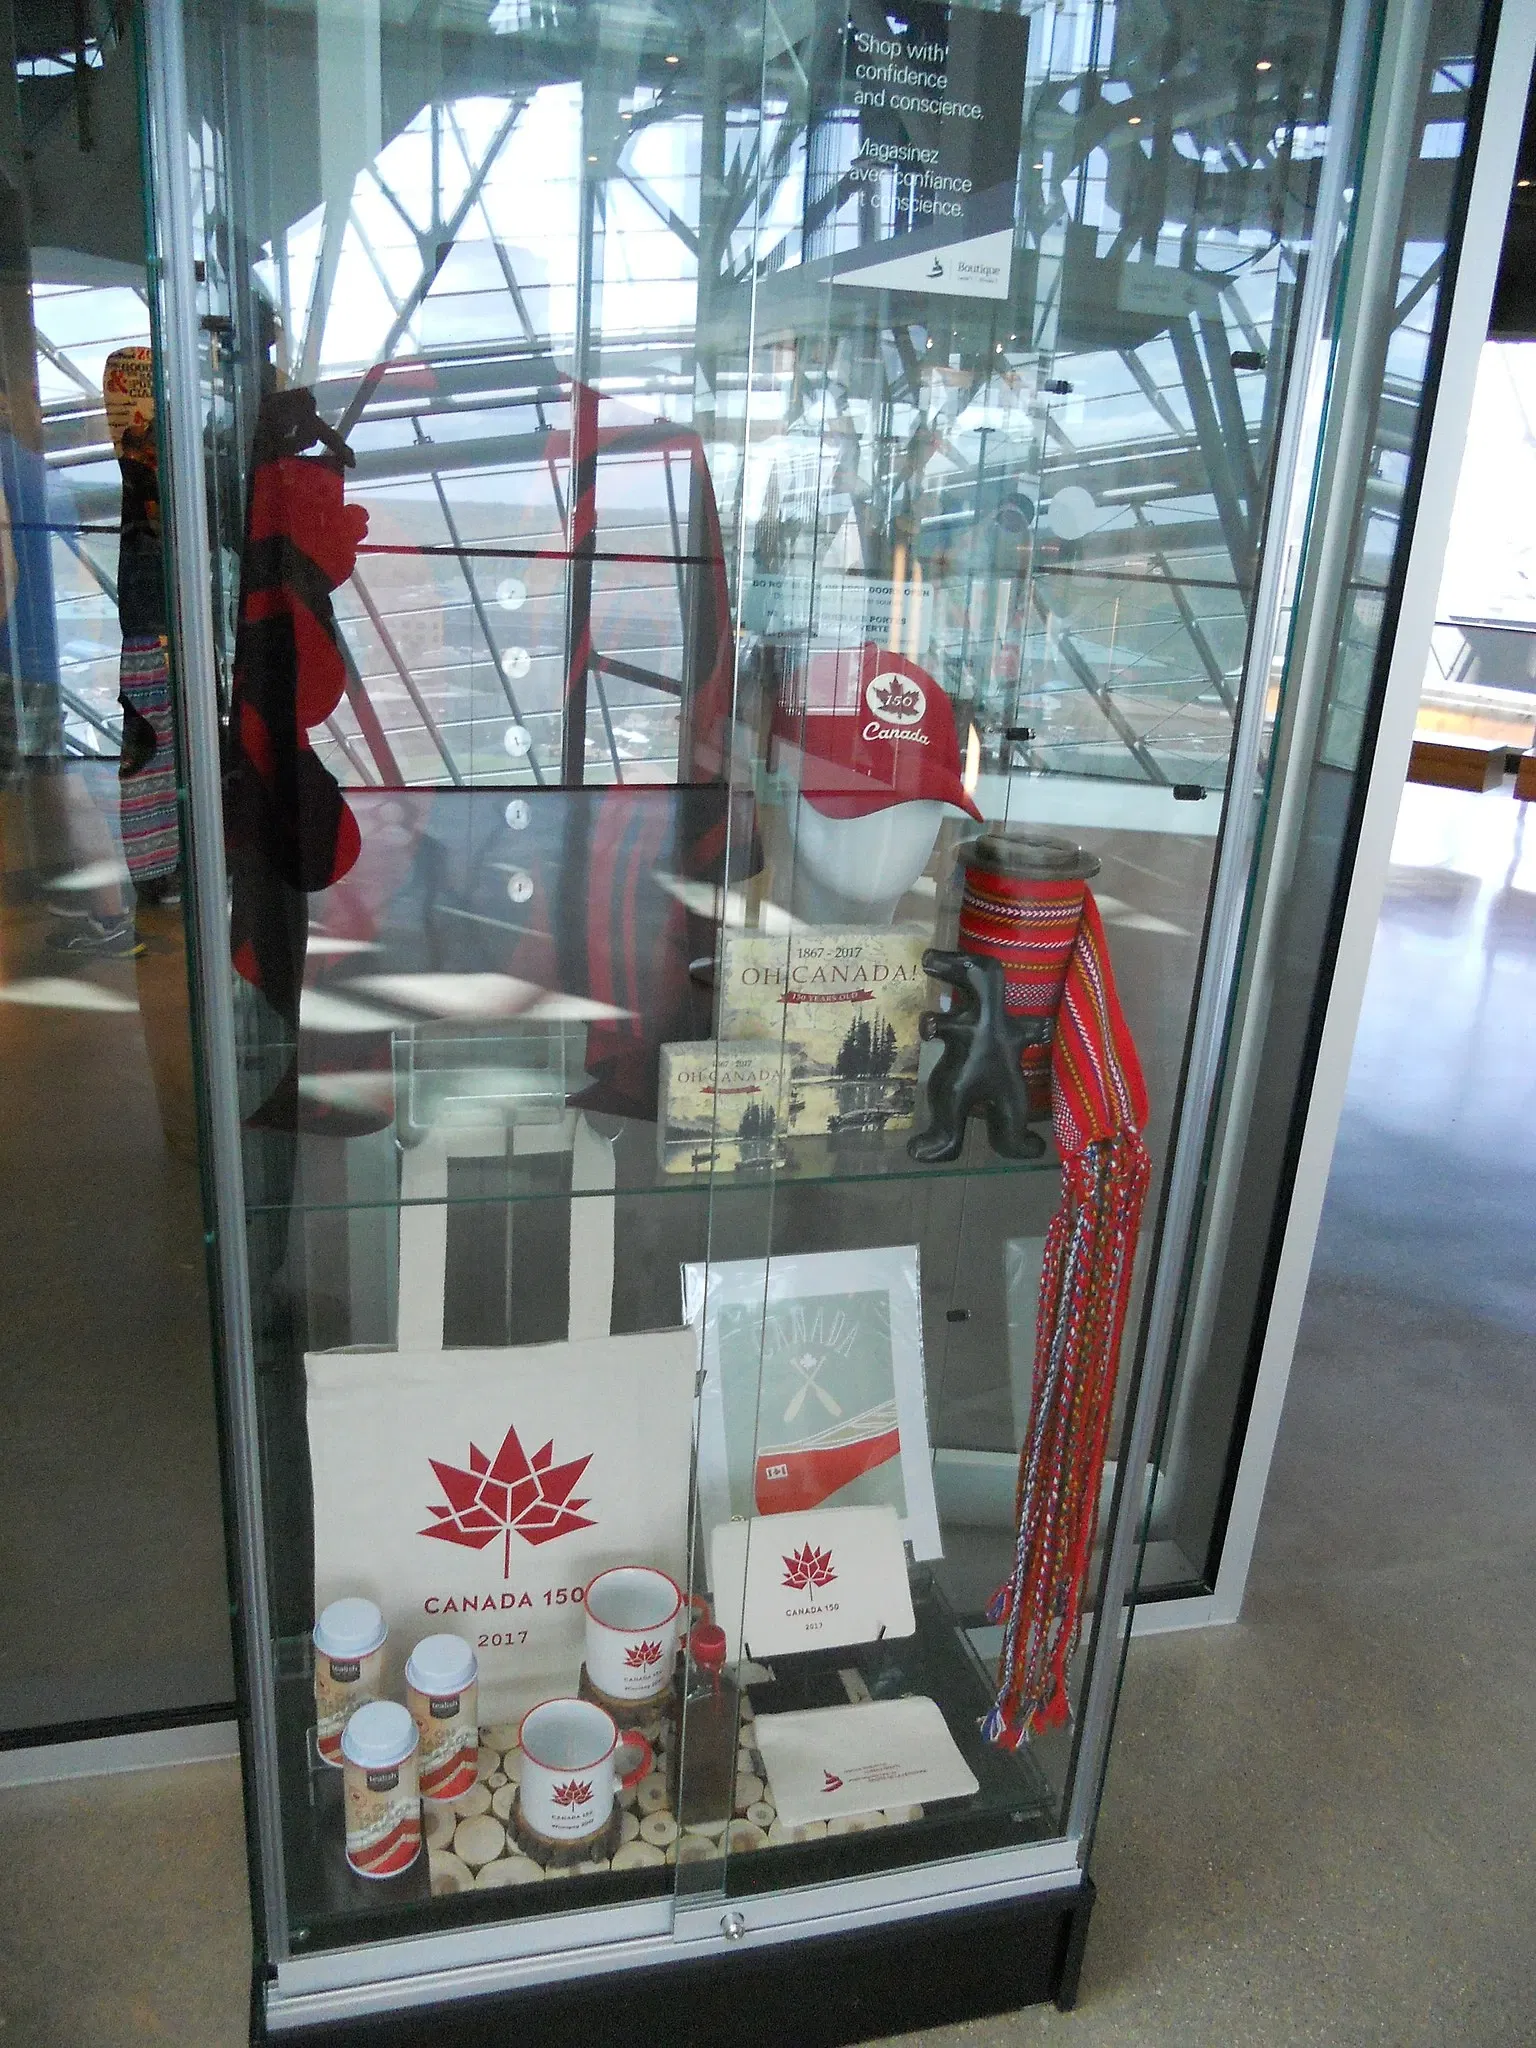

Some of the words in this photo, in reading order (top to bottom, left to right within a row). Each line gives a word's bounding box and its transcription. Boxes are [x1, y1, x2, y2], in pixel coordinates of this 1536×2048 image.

[857, 32, 902, 59] Shop
[906, 42, 944, 62] with
[855, 63, 948, 89] confidence
[854, 89, 886, 107] and
[890, 96, 985, 120] conscience.
[895, 169, 973, 193] confiance
[957, 261, 1001, 277] Boutique
[885, 694, 913, 708] 150
[862, 721, 930, 745] Canada
[799, 947, 824, 959] 1867
[835, 947, 863, 959] 2017
[741, 967, 781, 986] OH
[792, 963, 917, 984] CANADA!
[809, 993, 837, 1002] YEARS
[839, 991, 858, 1000] OLD
[678, 1071, 704, 1083] OH
[752, 1306, 860, 1360] CANADA
[424, 1591, 533, 1615] CANADA
[543, 1586, 585, 1606] 150
[785, 1606, 822, 1616] CANADA
[825, 1603, 840, 1611] 150
[805, 1622, 823, 1631] 2017
[477, 1630, 529, 1648] 2017
